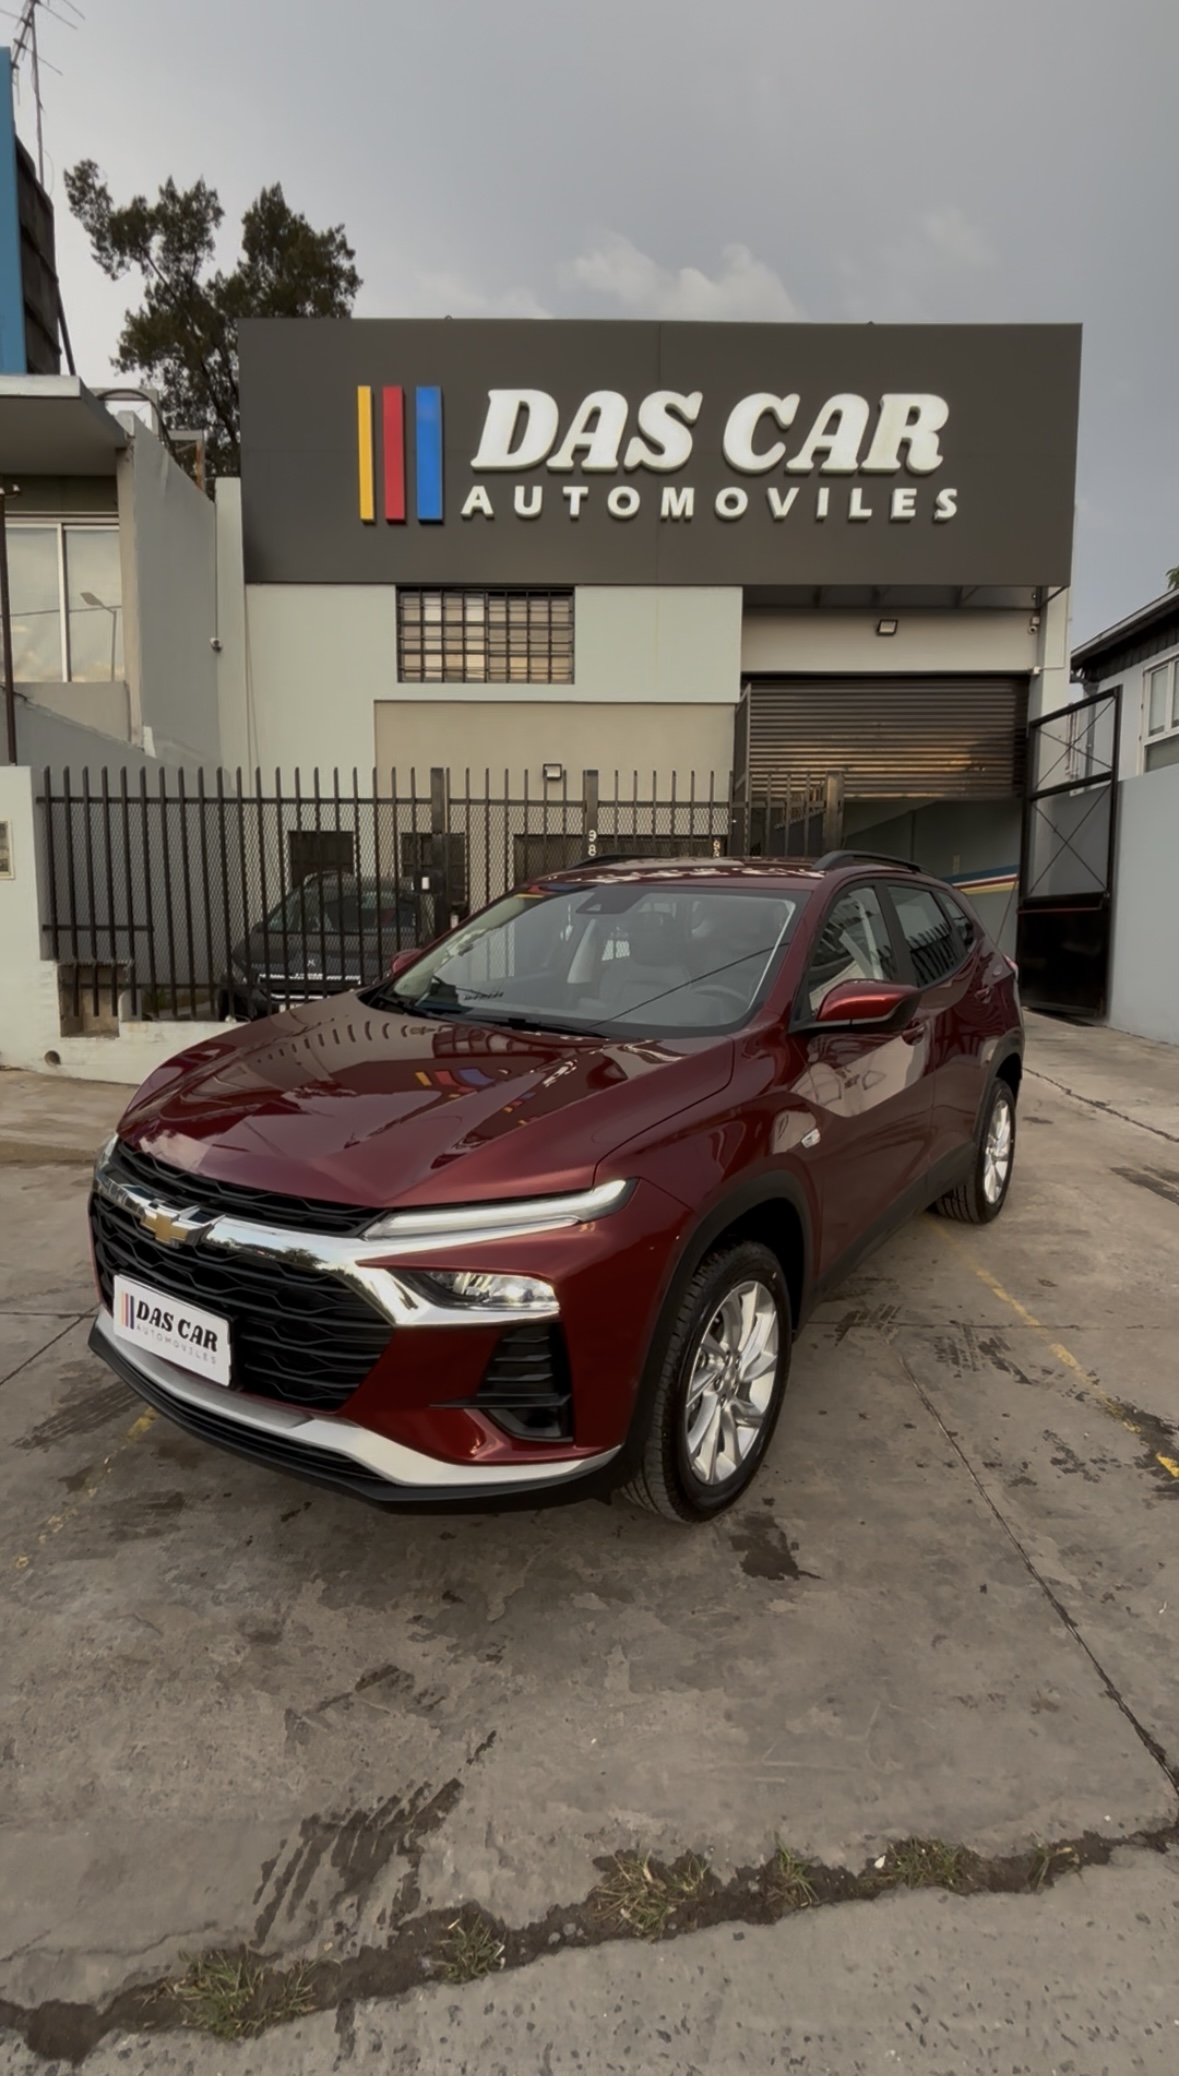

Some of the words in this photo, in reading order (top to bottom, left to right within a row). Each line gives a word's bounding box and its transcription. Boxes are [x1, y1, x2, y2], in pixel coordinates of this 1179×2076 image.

[470, 388, 703, 472] DAS
[722, 392, 950, 474] CAR
[460, 485, 959, 522] AUTOMOVILES
[136, 1300, 173, 1332] DAS
[177, 1318, 218, 1352] CAR
[136, 1324, 217, 1365] AUTOMOVILES
